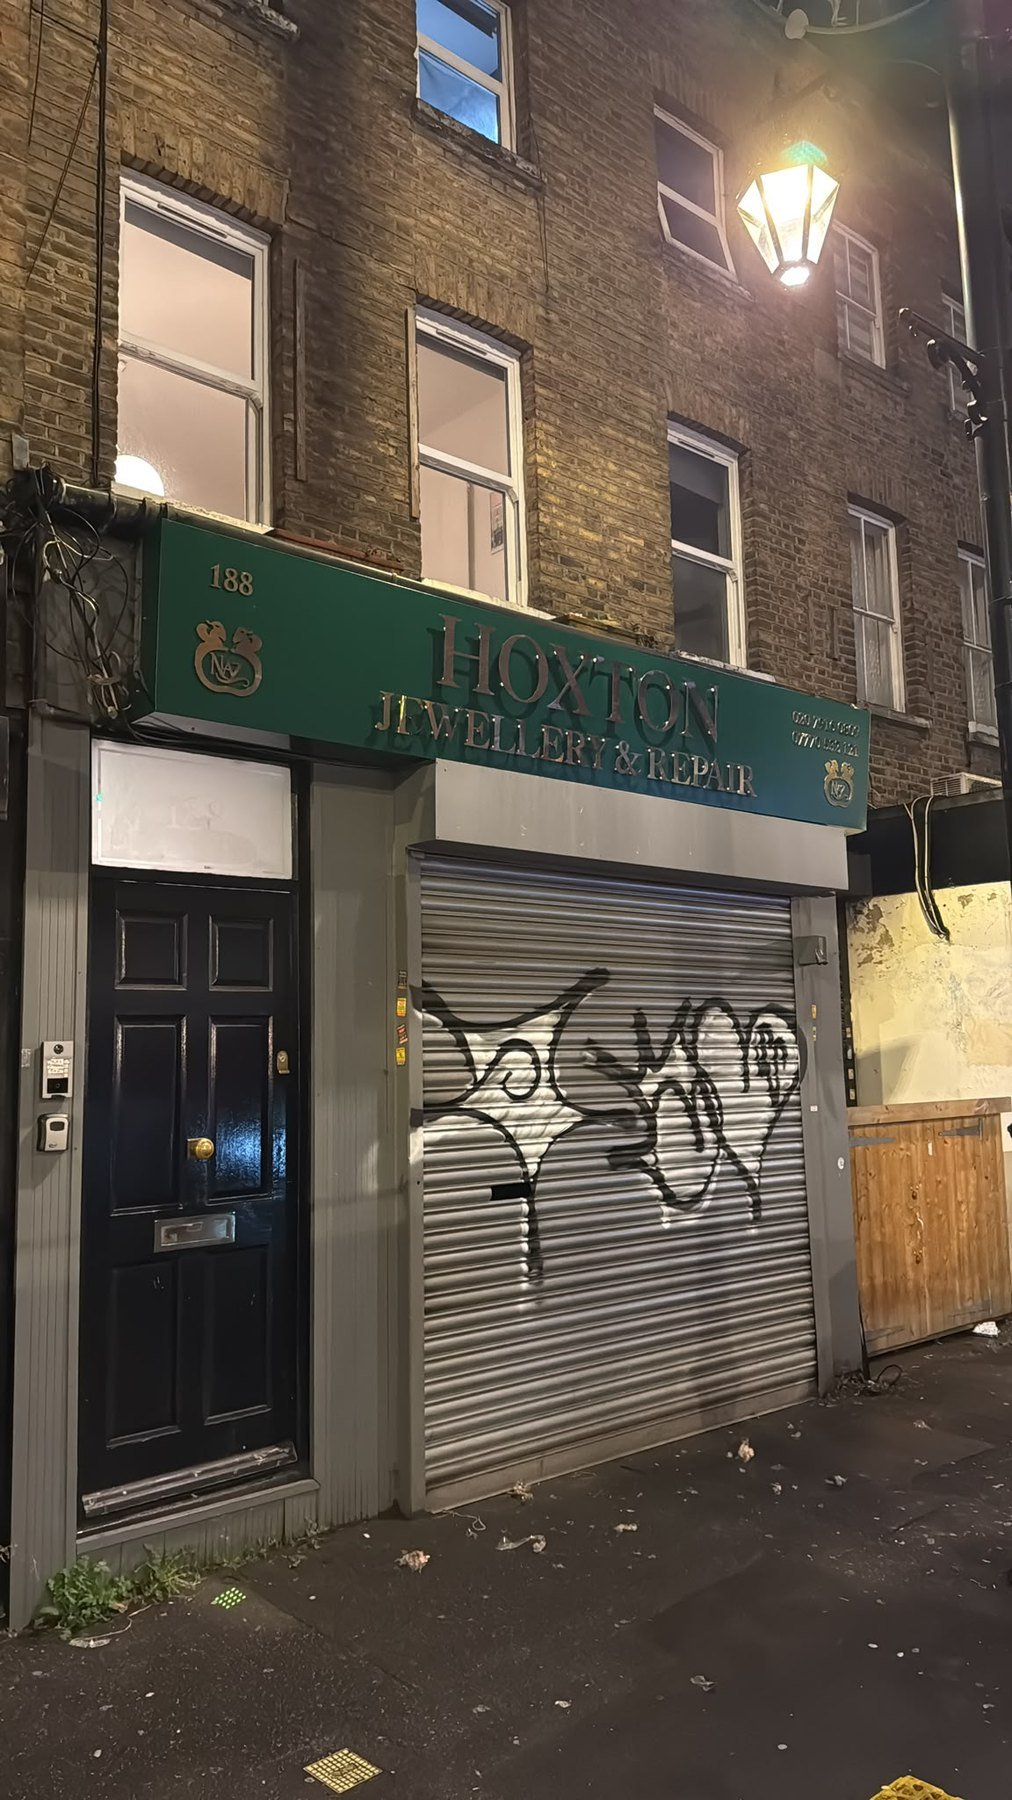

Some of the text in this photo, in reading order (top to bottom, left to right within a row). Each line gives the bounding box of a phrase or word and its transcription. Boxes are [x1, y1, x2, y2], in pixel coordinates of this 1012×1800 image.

[209, 563, 254, 596] 188
[436, 613, 720, 743] HOXTON
[375, 690, 758, 797] JEWELLERY & REPAIR
